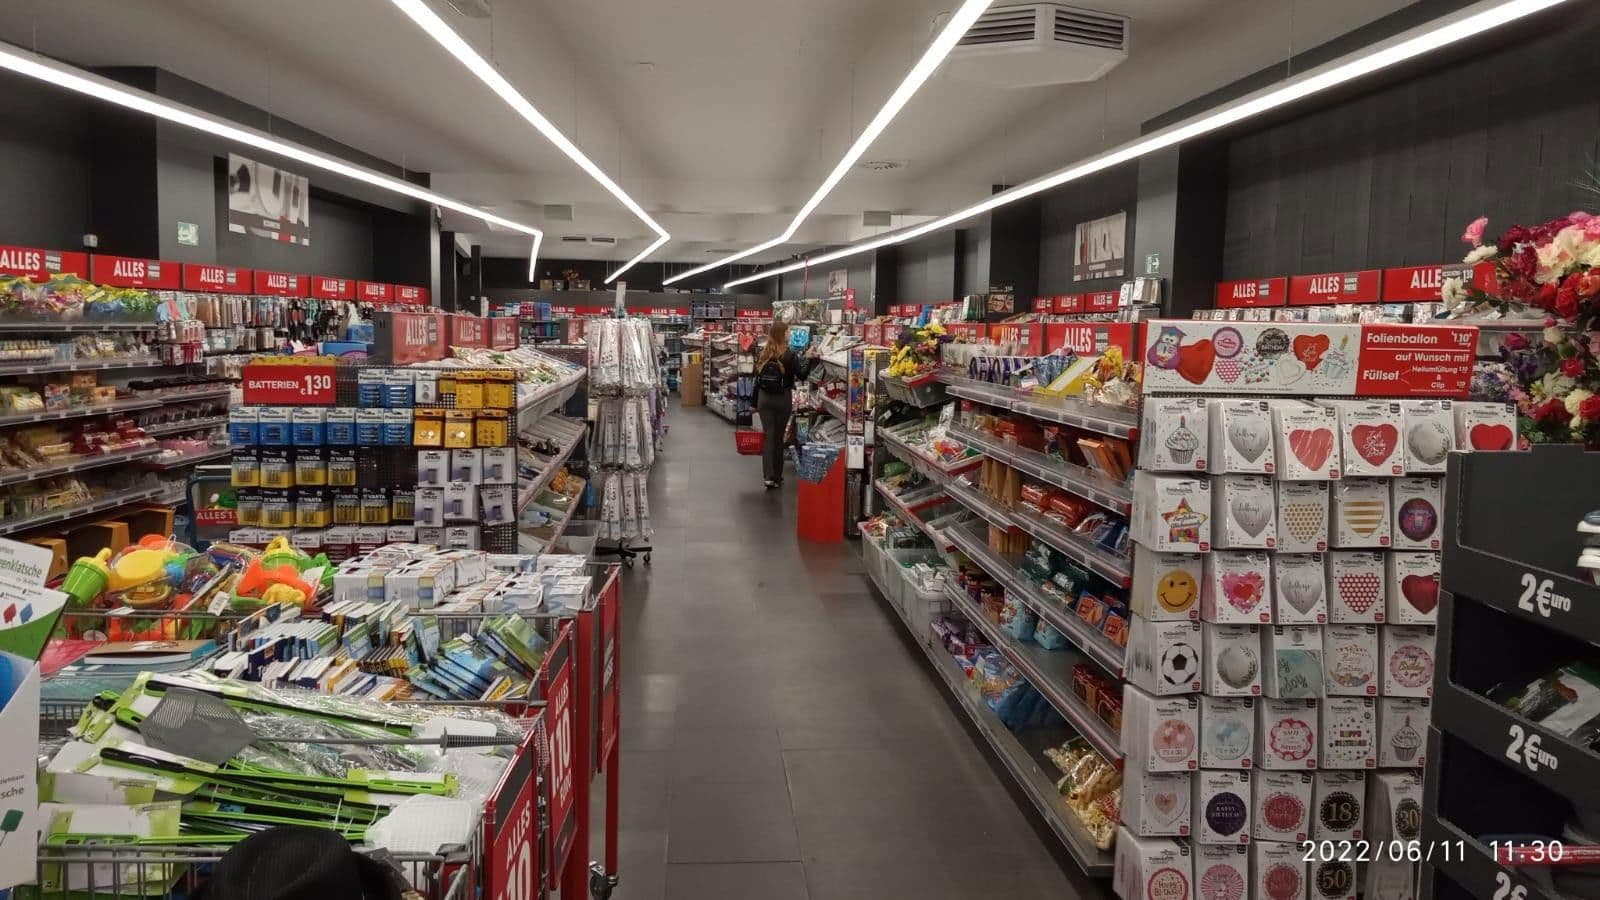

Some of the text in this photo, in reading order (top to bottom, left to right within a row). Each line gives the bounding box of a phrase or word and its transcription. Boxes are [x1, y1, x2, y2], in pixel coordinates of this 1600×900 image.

[1, 250, 41, 270] ALLES
[114, 260, 145, 277] ALLES
[200, 268, 224, 284] ALLES
[267, 275, 287, 288] ALLES
[322, 279, 338, 292] ALLES
[1310, 276, 1340, 294] ALLES
[1233, 283, 1256, 298] ALLES
[405, 319, 427, 345] ALLES
[1064, 327, 1092, 352] ALLES
[1366, 333, 1438, 345] Folienballon
[1395, 352, 1470, 362] auf Wunsch mit
[1363, 369, 1400, 380] Füllset
[249, 380, 299, 389] BATTERIEN
[196, 511, 226, 520] ALLES
[555, 681, 569, 720] ALLES
[1329, 802, 1352, 822] 18
[506, 800, 531, 871] ALLES
[1323, 869, 1347, 889] 50
